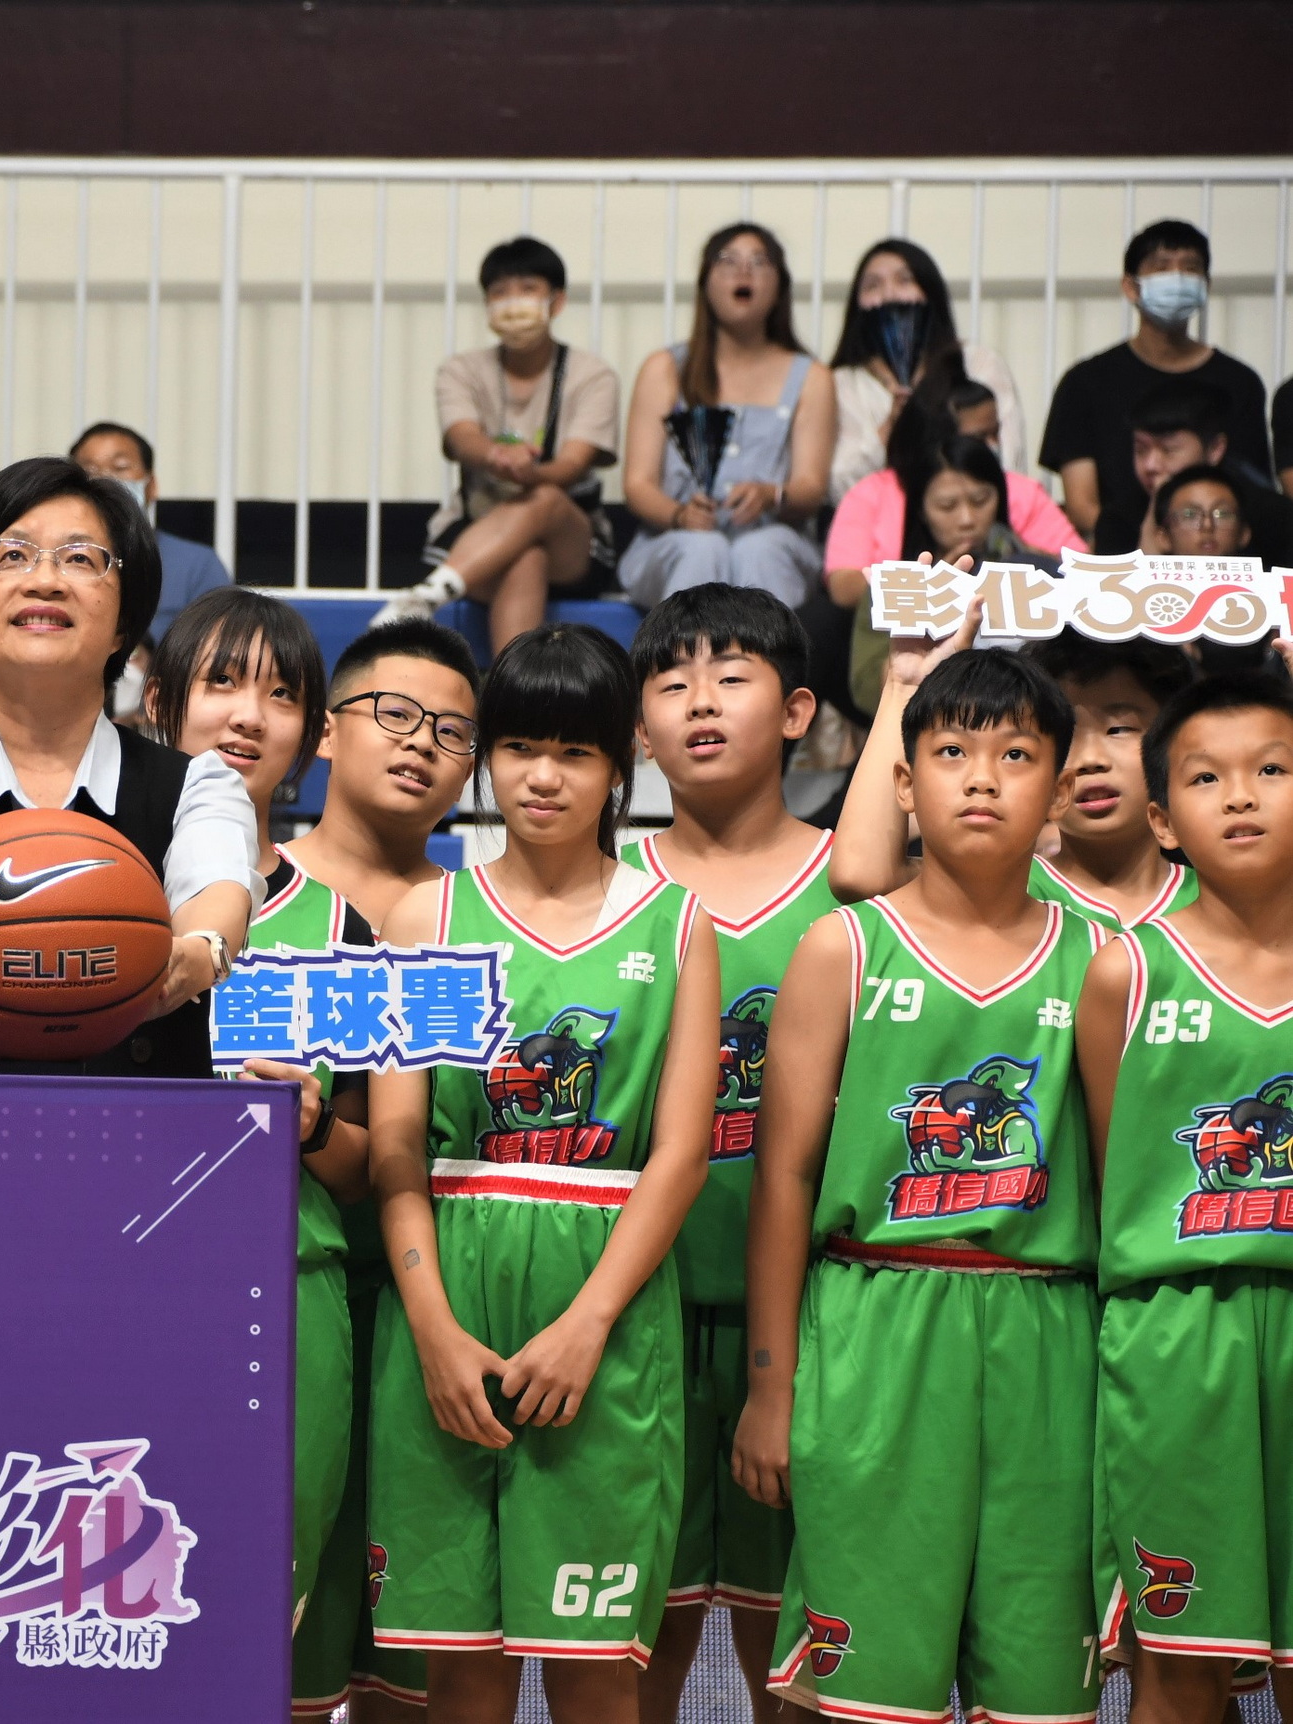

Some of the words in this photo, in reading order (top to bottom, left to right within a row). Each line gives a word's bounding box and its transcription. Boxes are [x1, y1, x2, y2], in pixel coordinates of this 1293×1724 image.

[882, 567, 1058, 630] 彰化
[2, 945, 118, 980] ELITE
[2, 977, 117, 989] CHAMPIONSHIP
[212, 965, 487, 1052] 籃球賽
[862, 976, 925, 1022] 79
[1144, 999, 1213, 1045] 83
[889, 1166, 1050, 1220] 僑信國小
[551, 1563, 639, 1617] 62
[22, 1622, 164, 1665] 縣政府
